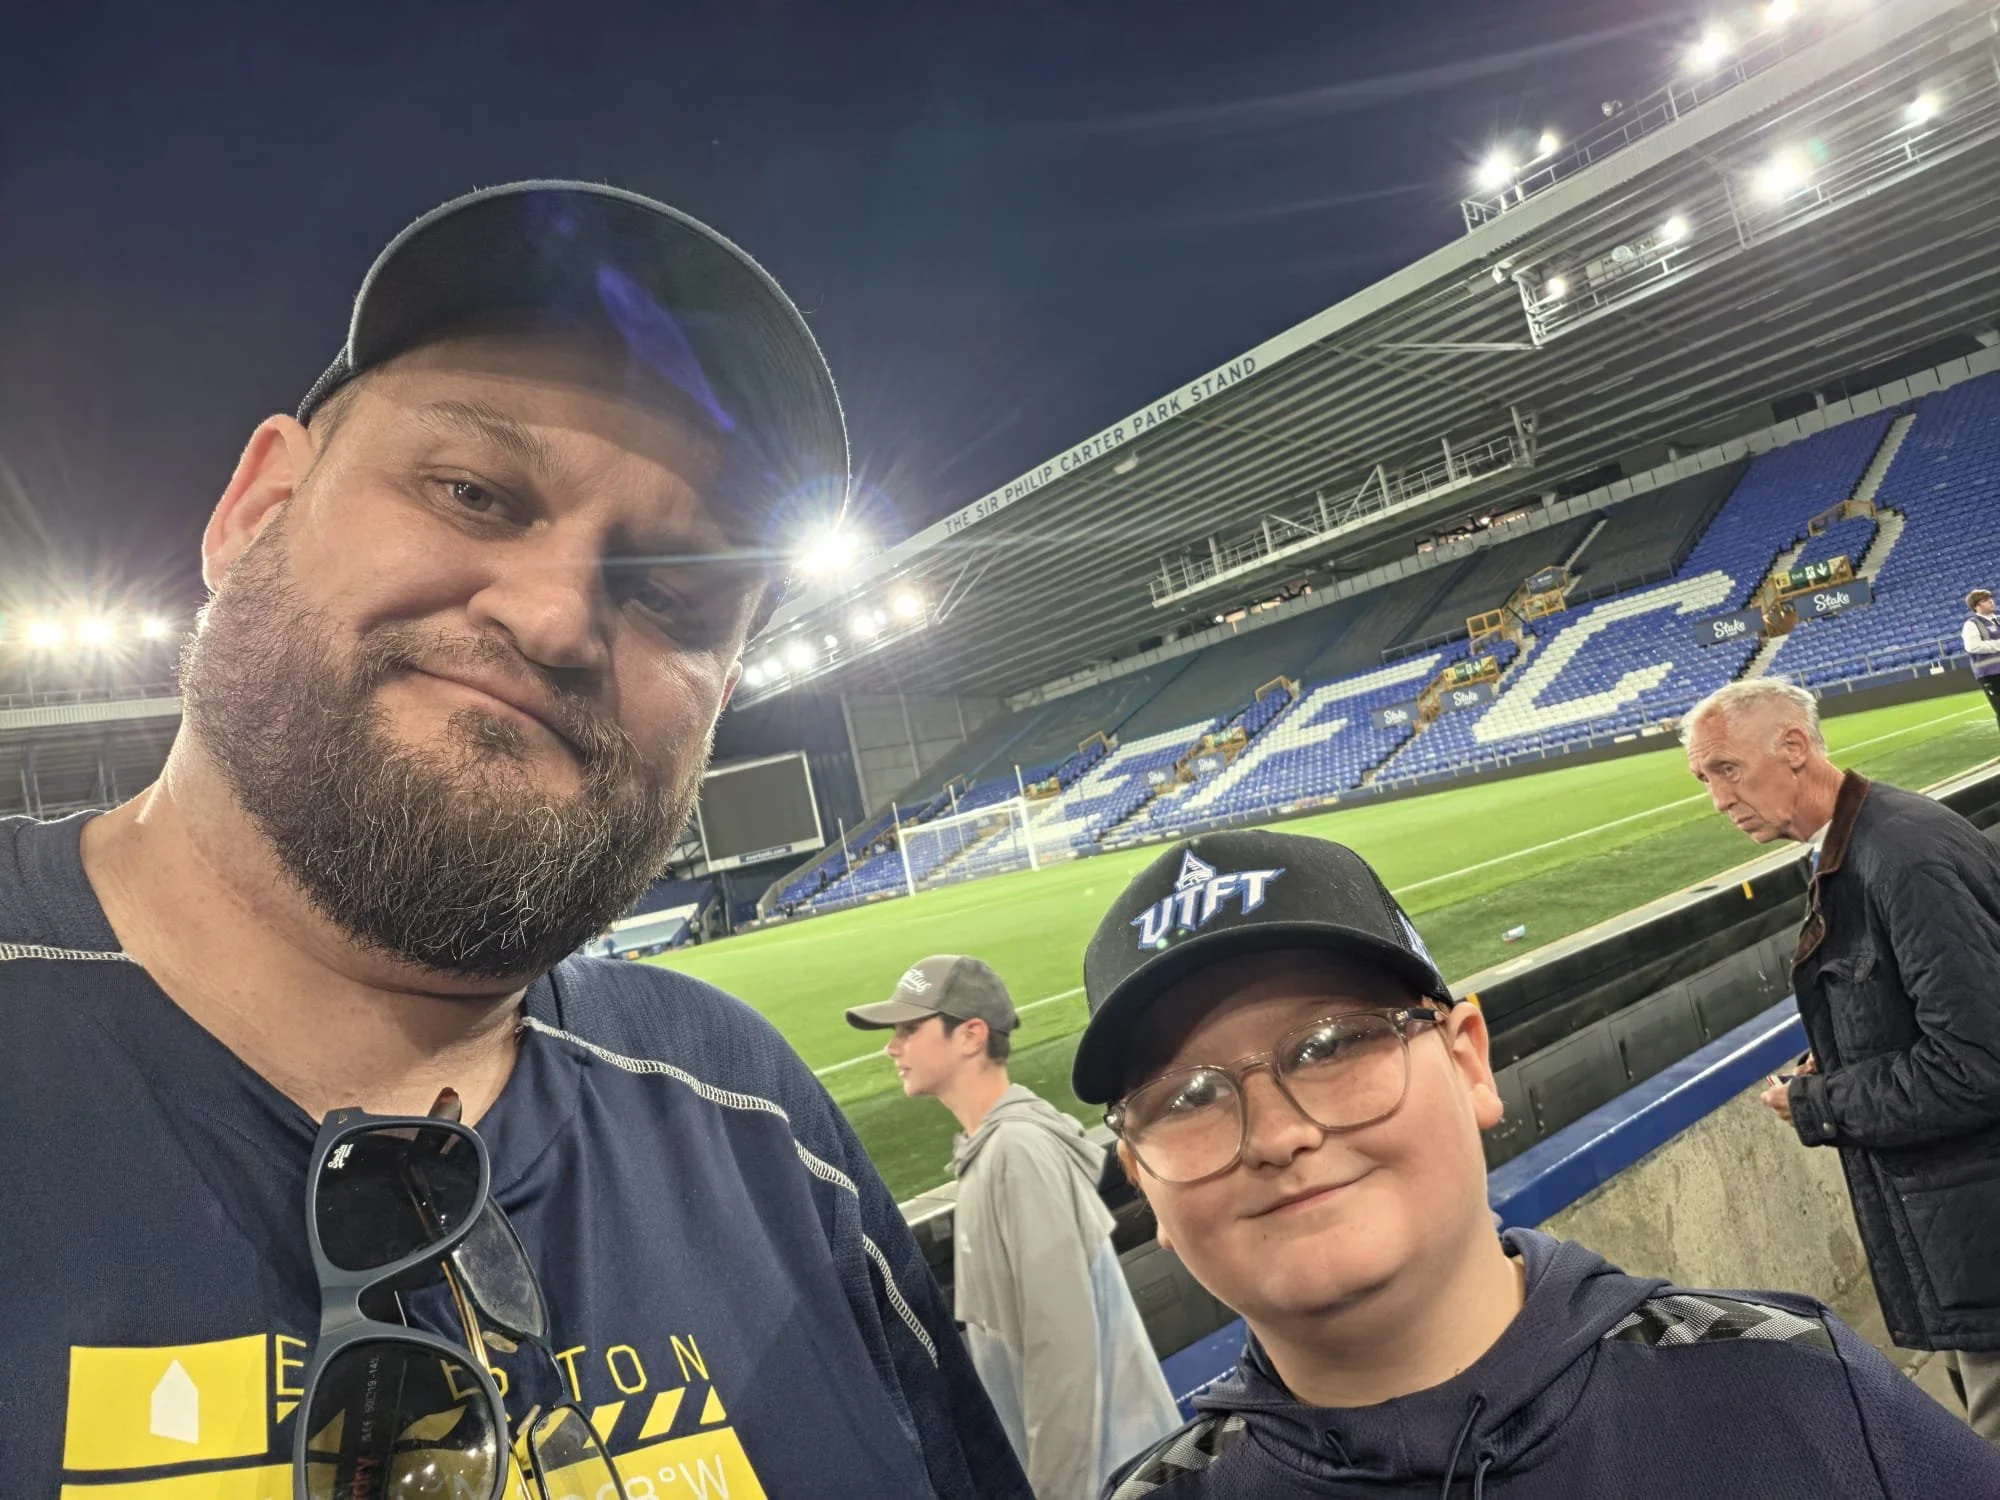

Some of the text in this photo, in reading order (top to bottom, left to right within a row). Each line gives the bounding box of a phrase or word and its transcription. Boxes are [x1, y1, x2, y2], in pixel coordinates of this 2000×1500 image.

[945, 357, 1256, 535] THE SIR PHILIP CARTER PARK STAND
[1713, 619, 1746, 639] Stake
[1814, 591, 1850, 611] Stake
[1130, 868, 1286, 949] UTFT
[276, 1334, 709, 1422] EETON
